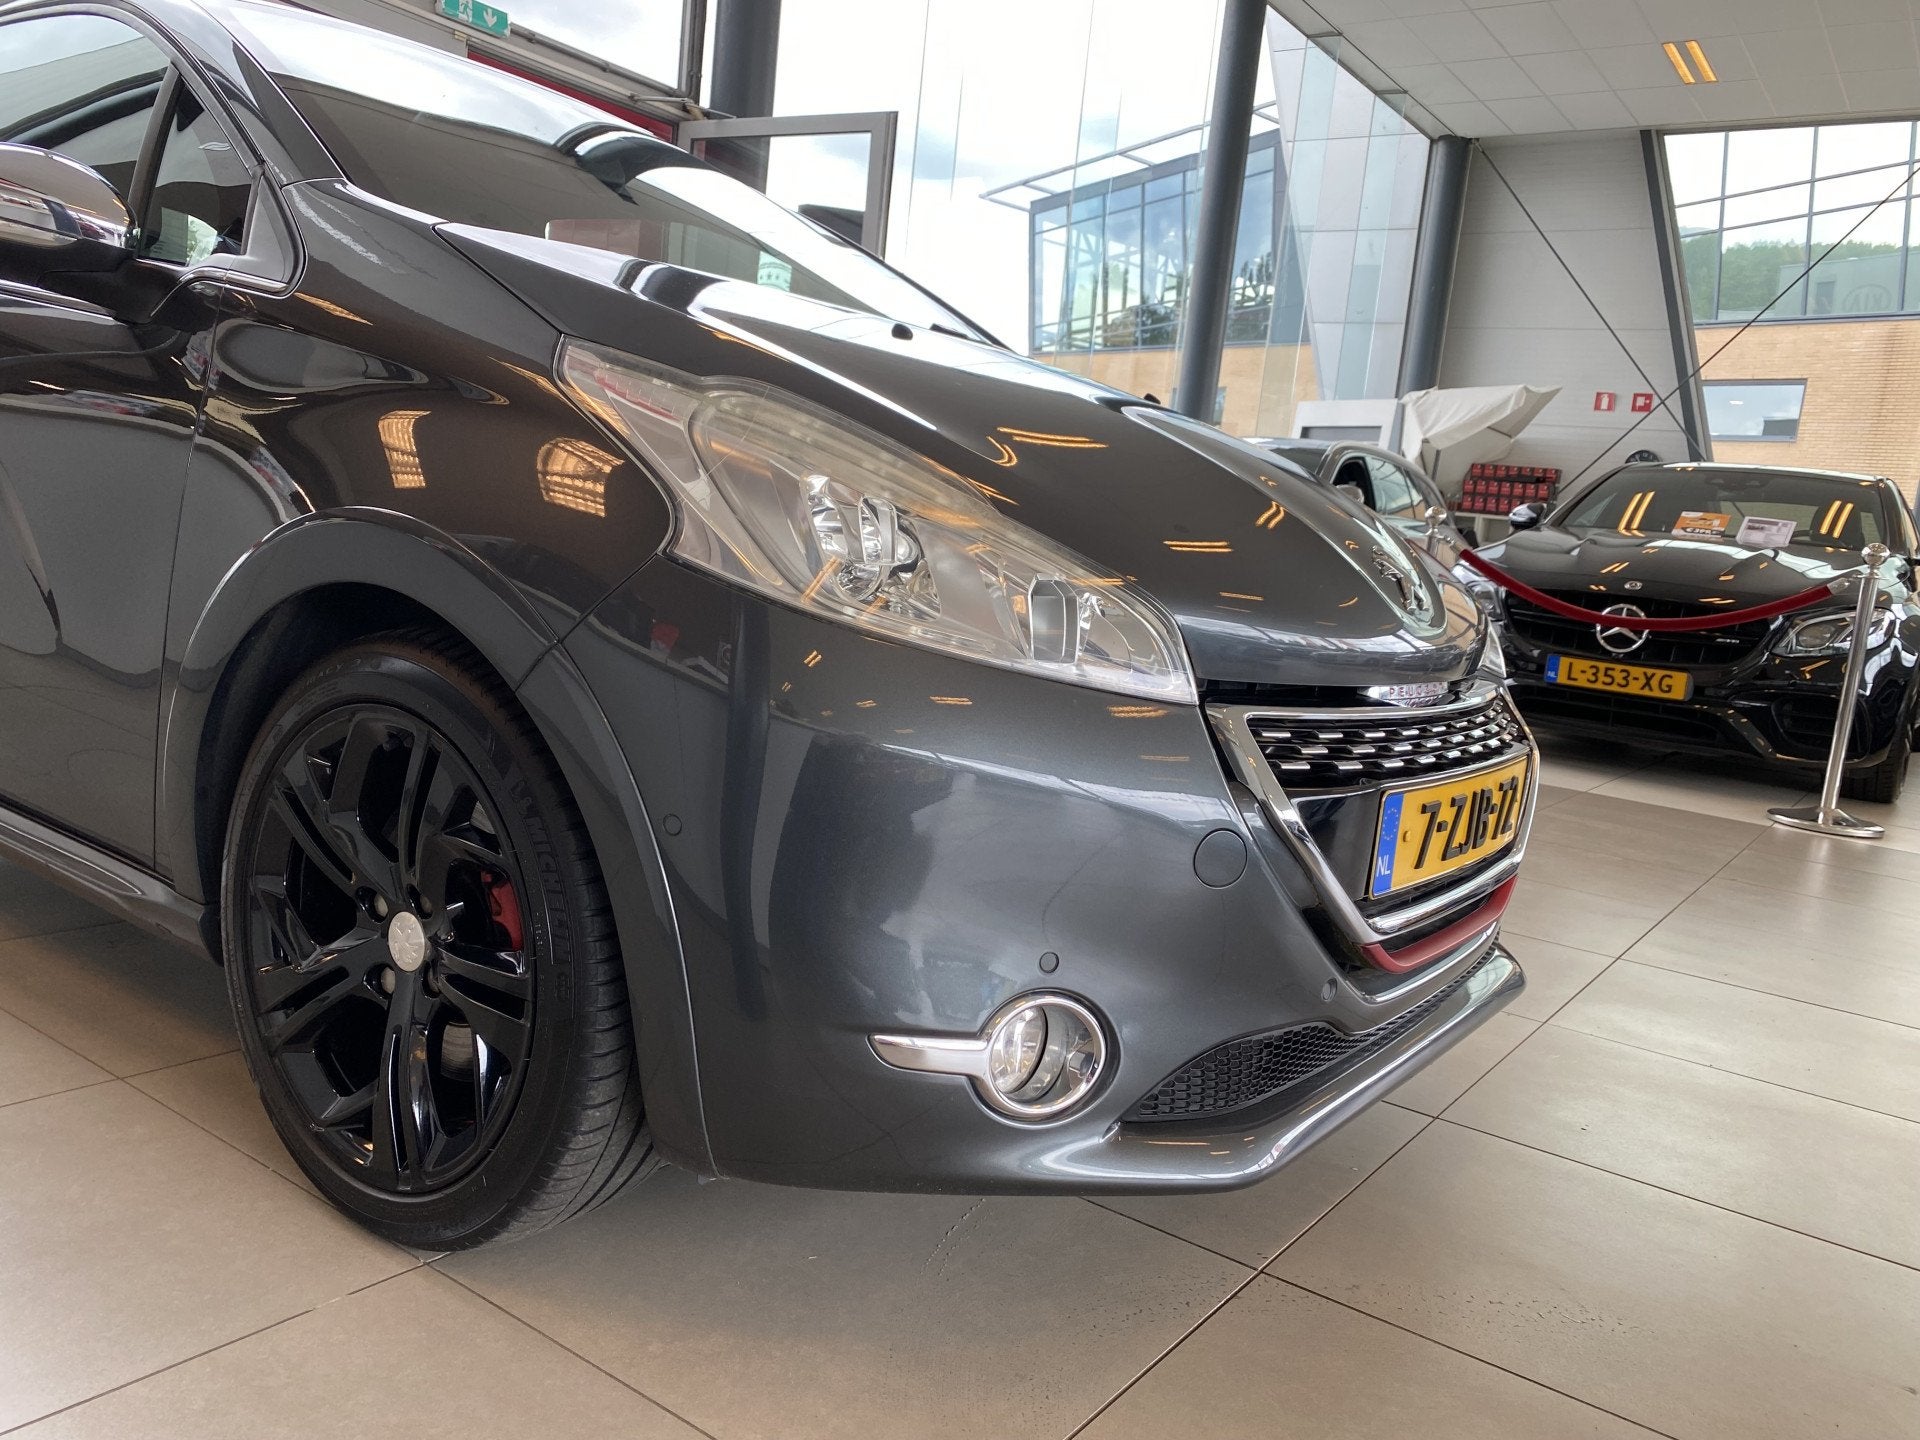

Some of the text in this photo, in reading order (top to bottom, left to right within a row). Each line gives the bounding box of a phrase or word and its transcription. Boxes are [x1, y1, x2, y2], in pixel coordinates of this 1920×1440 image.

[1547, 670, 1557, 678] NL
[1566, 661, 1674, 694] L-353-XG
[1376, 854, 1391, 877] NL
